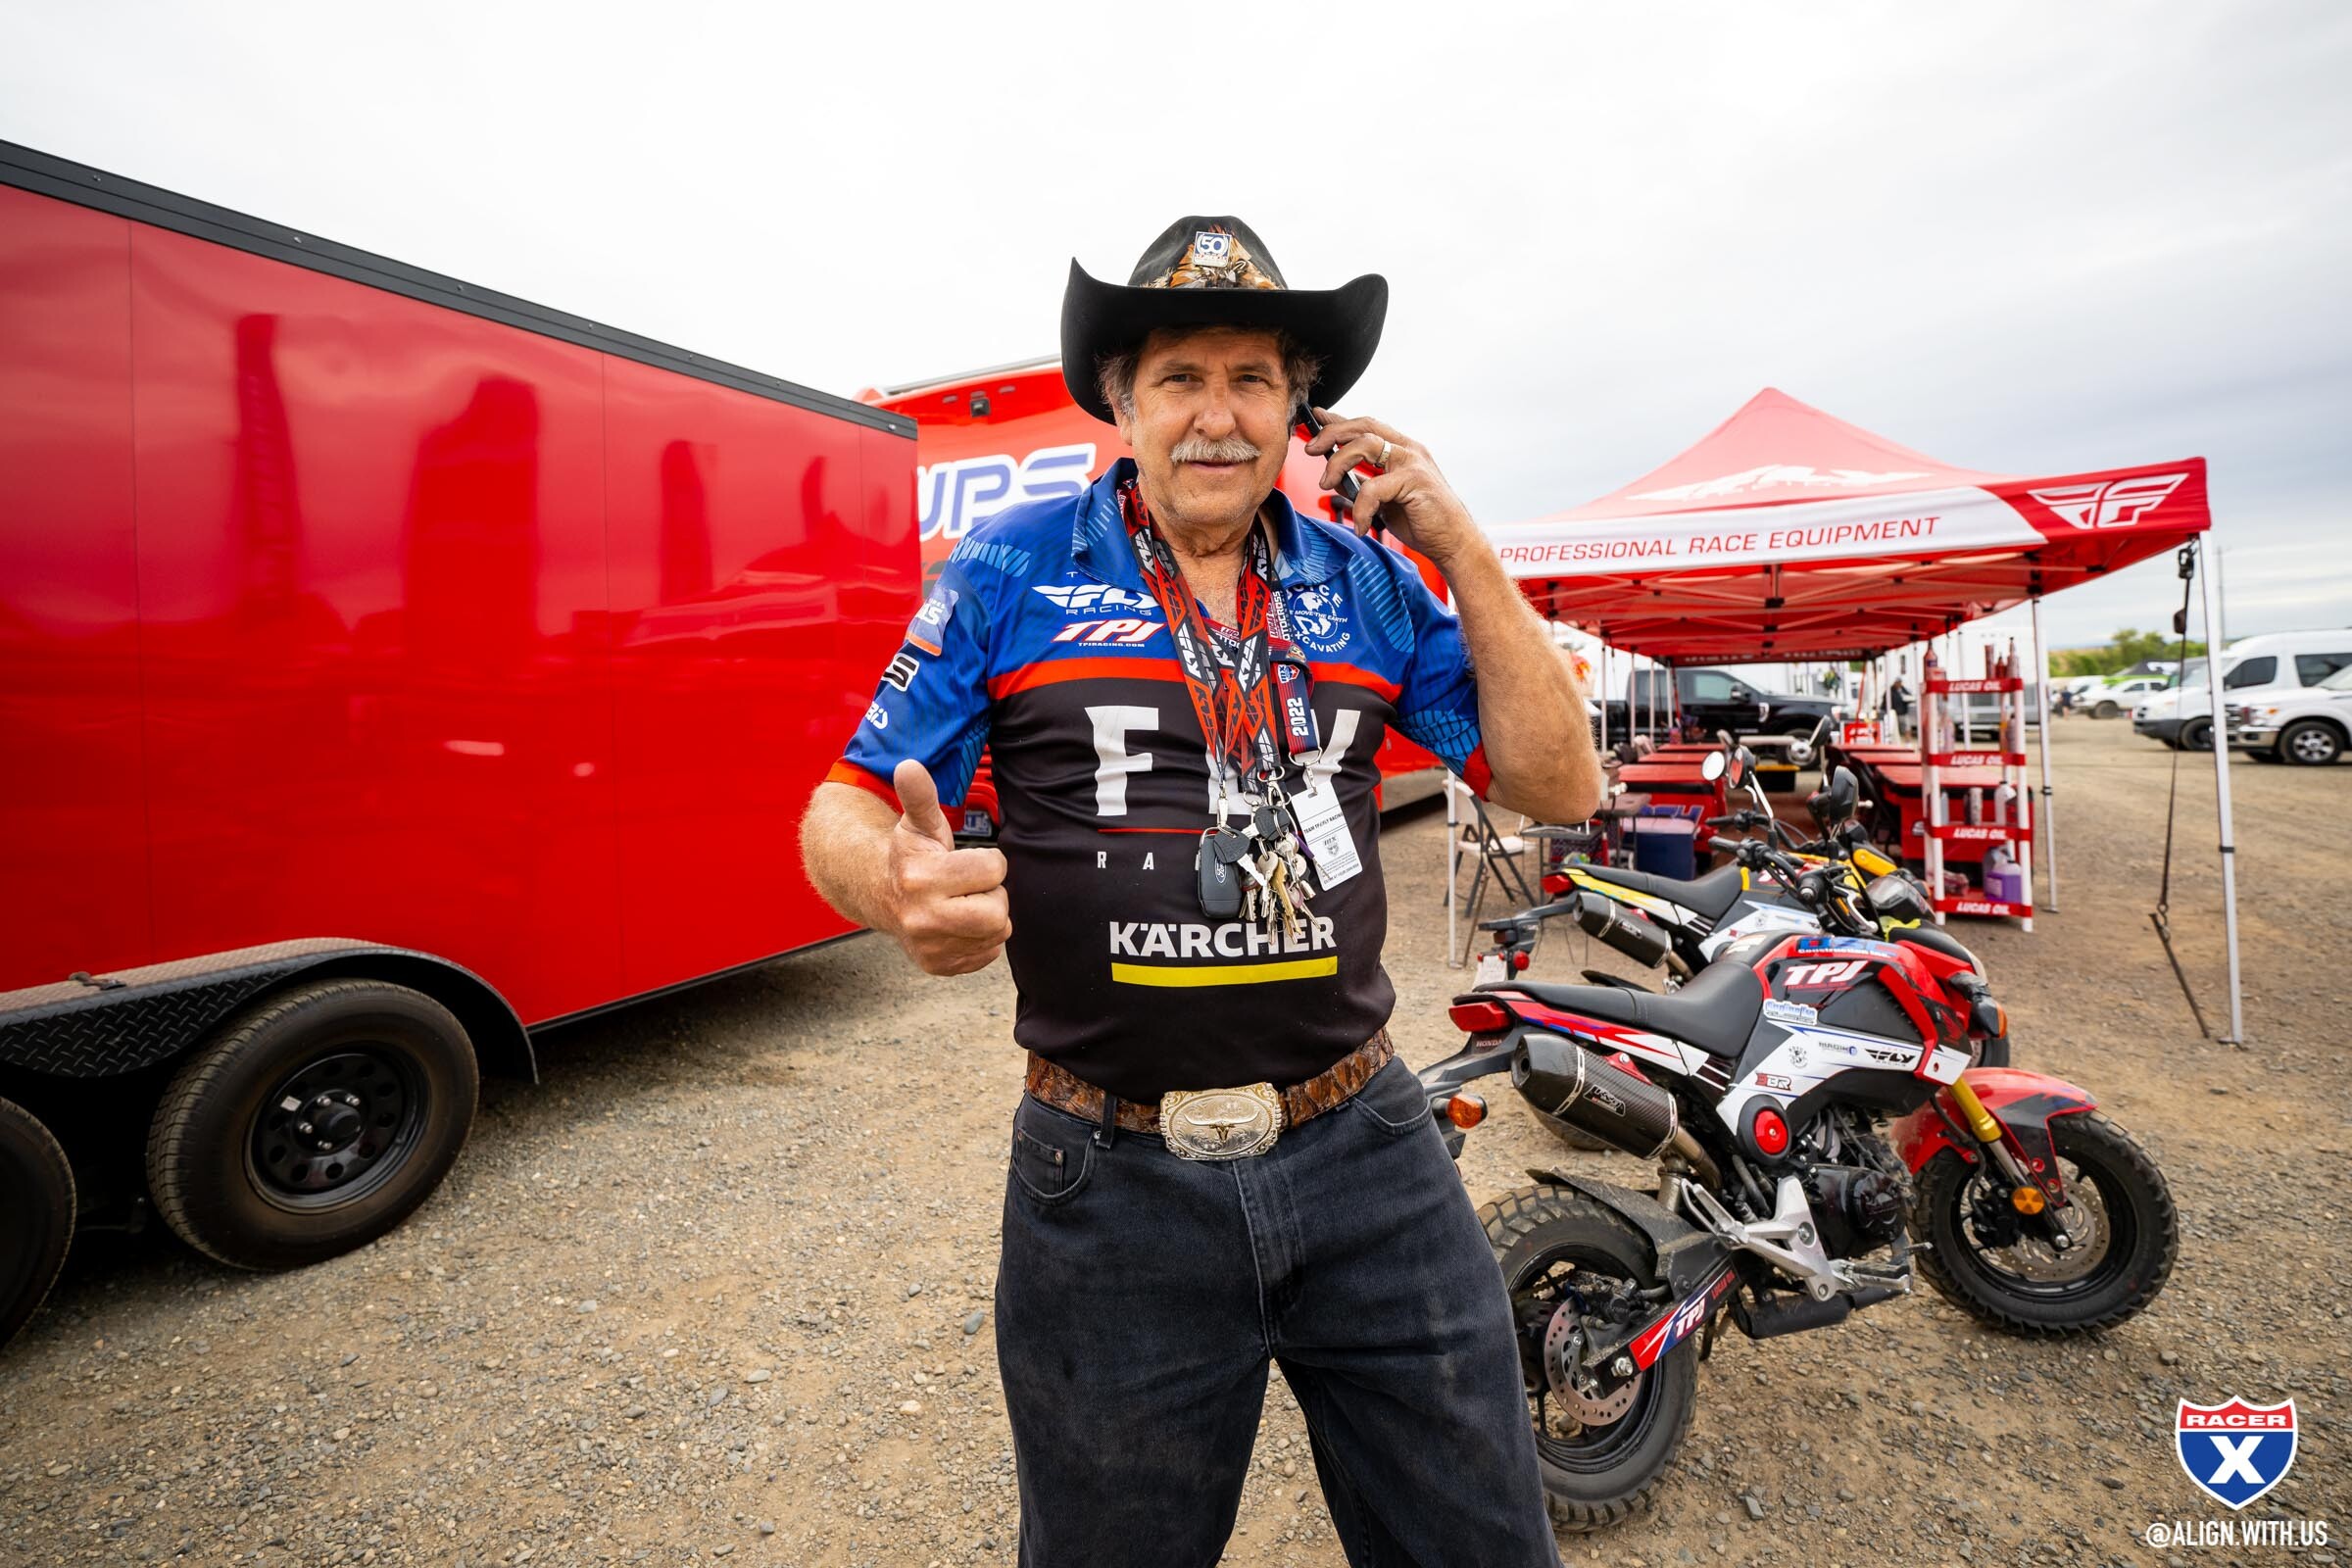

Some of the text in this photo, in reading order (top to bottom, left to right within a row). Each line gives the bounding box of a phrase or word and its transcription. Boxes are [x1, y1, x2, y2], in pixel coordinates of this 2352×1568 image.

[1499, 515, 1941, 564] PROFESSIONAL RACE EQUIPMENT
[1033, 584, 1160, 609] FLY
[1066, 605, 1152, 616] RACING
[1272, 590, 1291, 641] OTOCROSS
[1052, 619, 1166, 642] TPJ
[1287, 697, 1309, 737] 2022
[1109, 916, 1338, 958] KÄRCHER
[1784, 960, 1869, 986] TPJ
[1865, 1049, 1916, 1062] FLY
